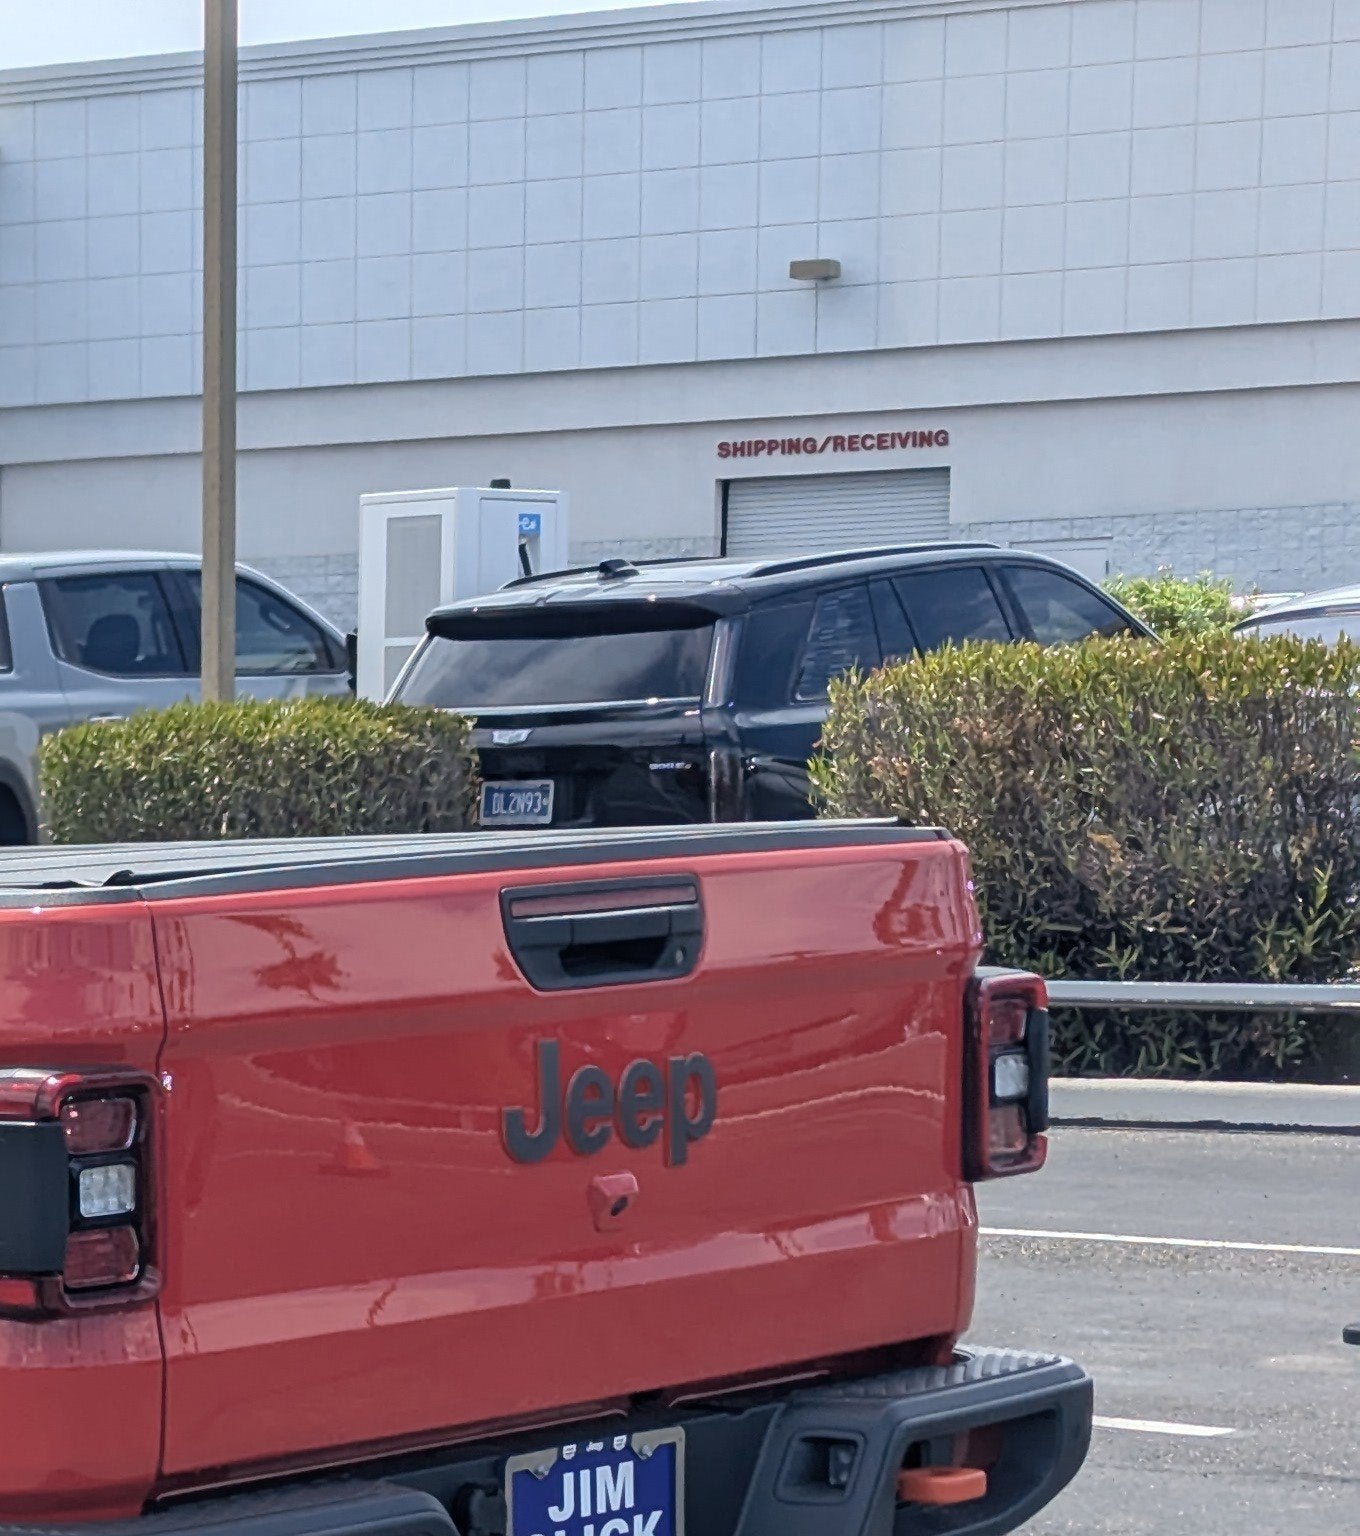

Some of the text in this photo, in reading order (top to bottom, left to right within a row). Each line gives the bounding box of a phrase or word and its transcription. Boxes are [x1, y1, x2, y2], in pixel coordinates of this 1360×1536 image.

[717, 429, 949, 458] SHIPPING/RECEIVING
[501, 1037, 717, 1167] Jeep
[547, 1460, 635, 1523] JIM
